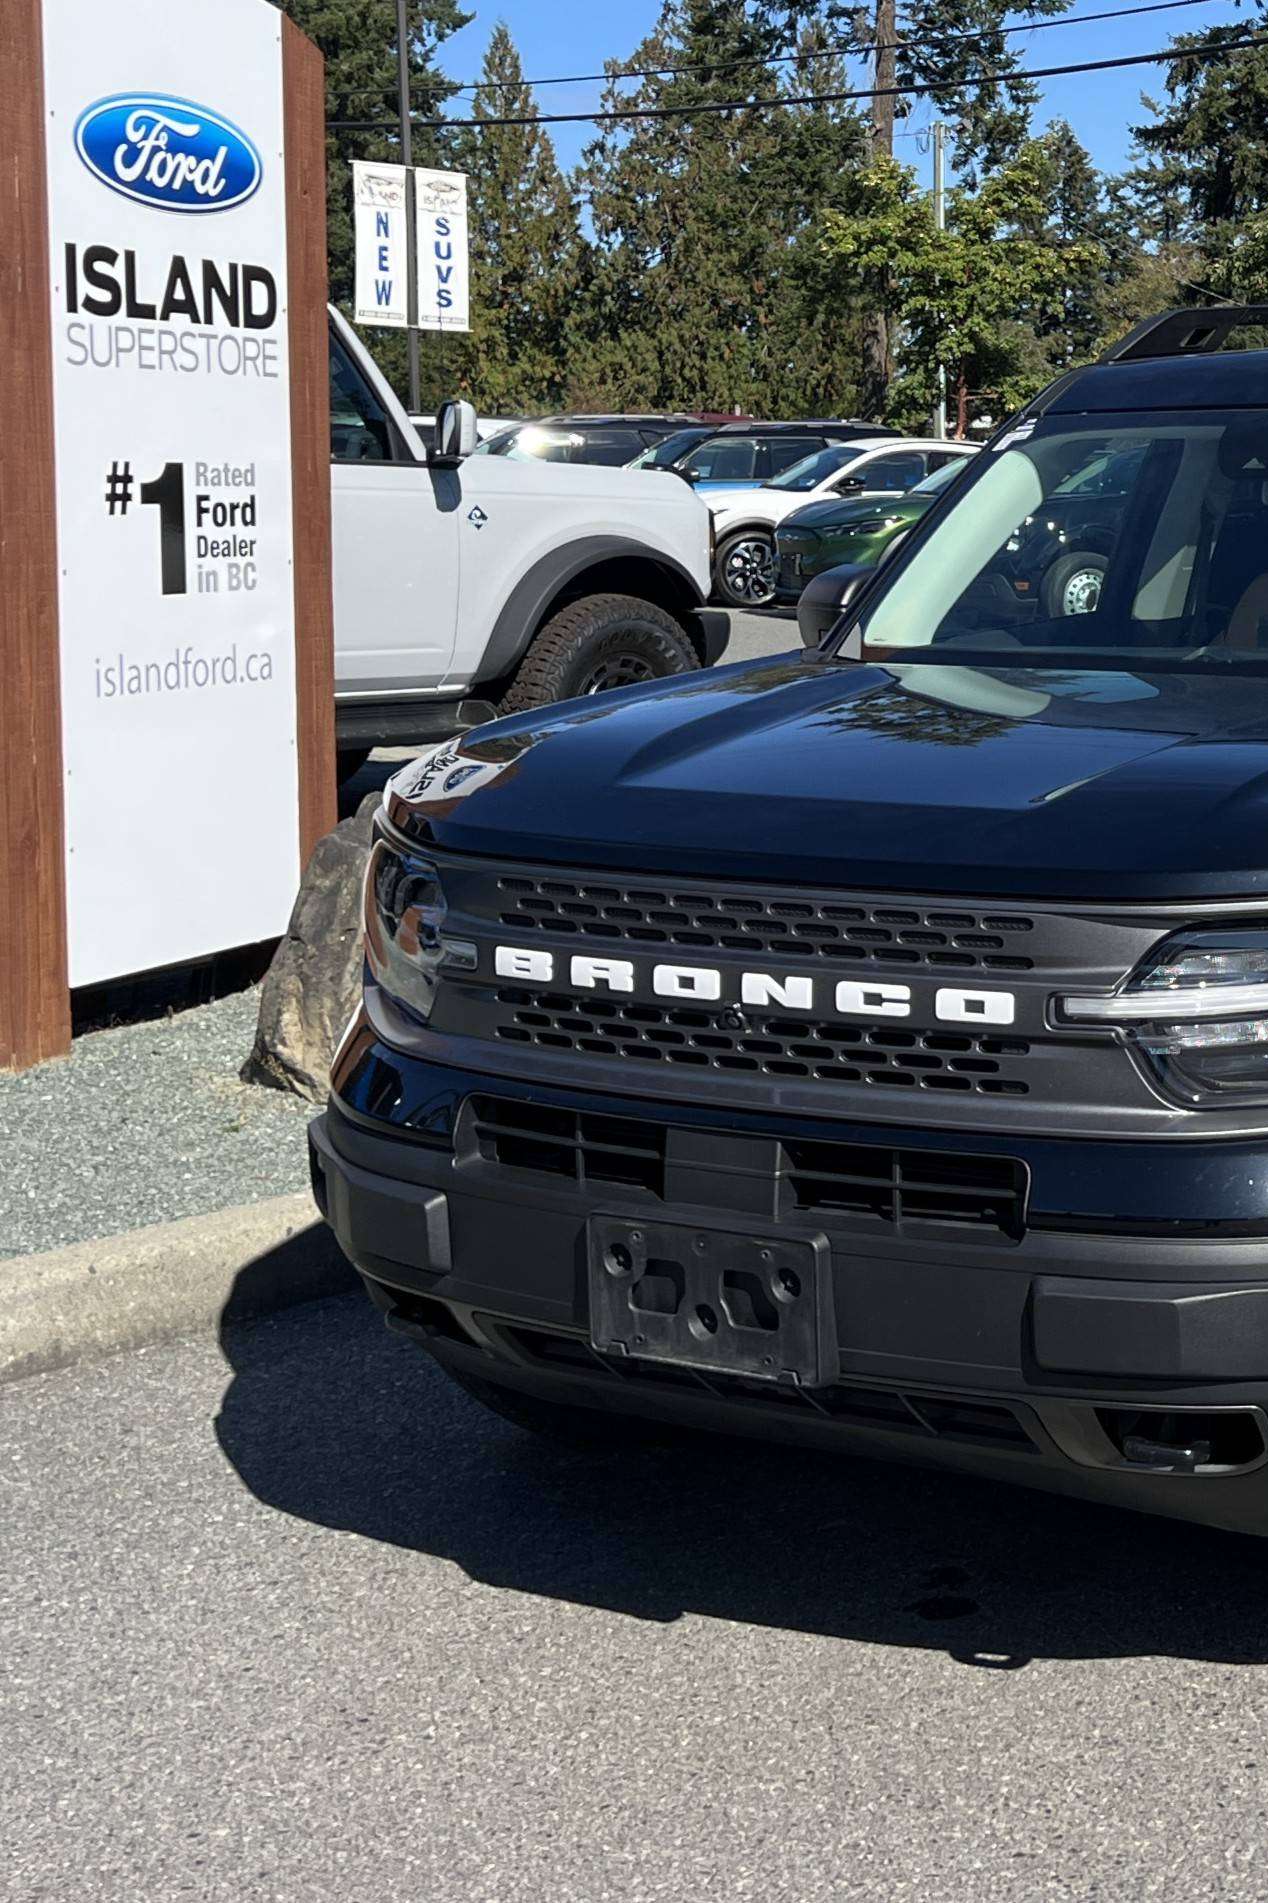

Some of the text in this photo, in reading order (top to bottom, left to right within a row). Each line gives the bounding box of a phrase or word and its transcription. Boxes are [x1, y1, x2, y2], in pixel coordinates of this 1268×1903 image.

[113, 109, 227, 197] Ford
[64, 242, 277, 330] ISLAND
[374, 211, 393, 307] NEW
[434, 216, 454, 308] SUVS
[66, 322, 279, 378] SUPERSTORE
[195, 462, 256, 487] Rated
[105, 461, 187, 595] #1
[196, 494, 257, 527] Ford
[197, 534, 257, 559] Dealer
[197, 561, 257, 593] in BC
[95, 643, 273, 698] islandford.ca
[494, 945, 1016, 1026] BRONCO
